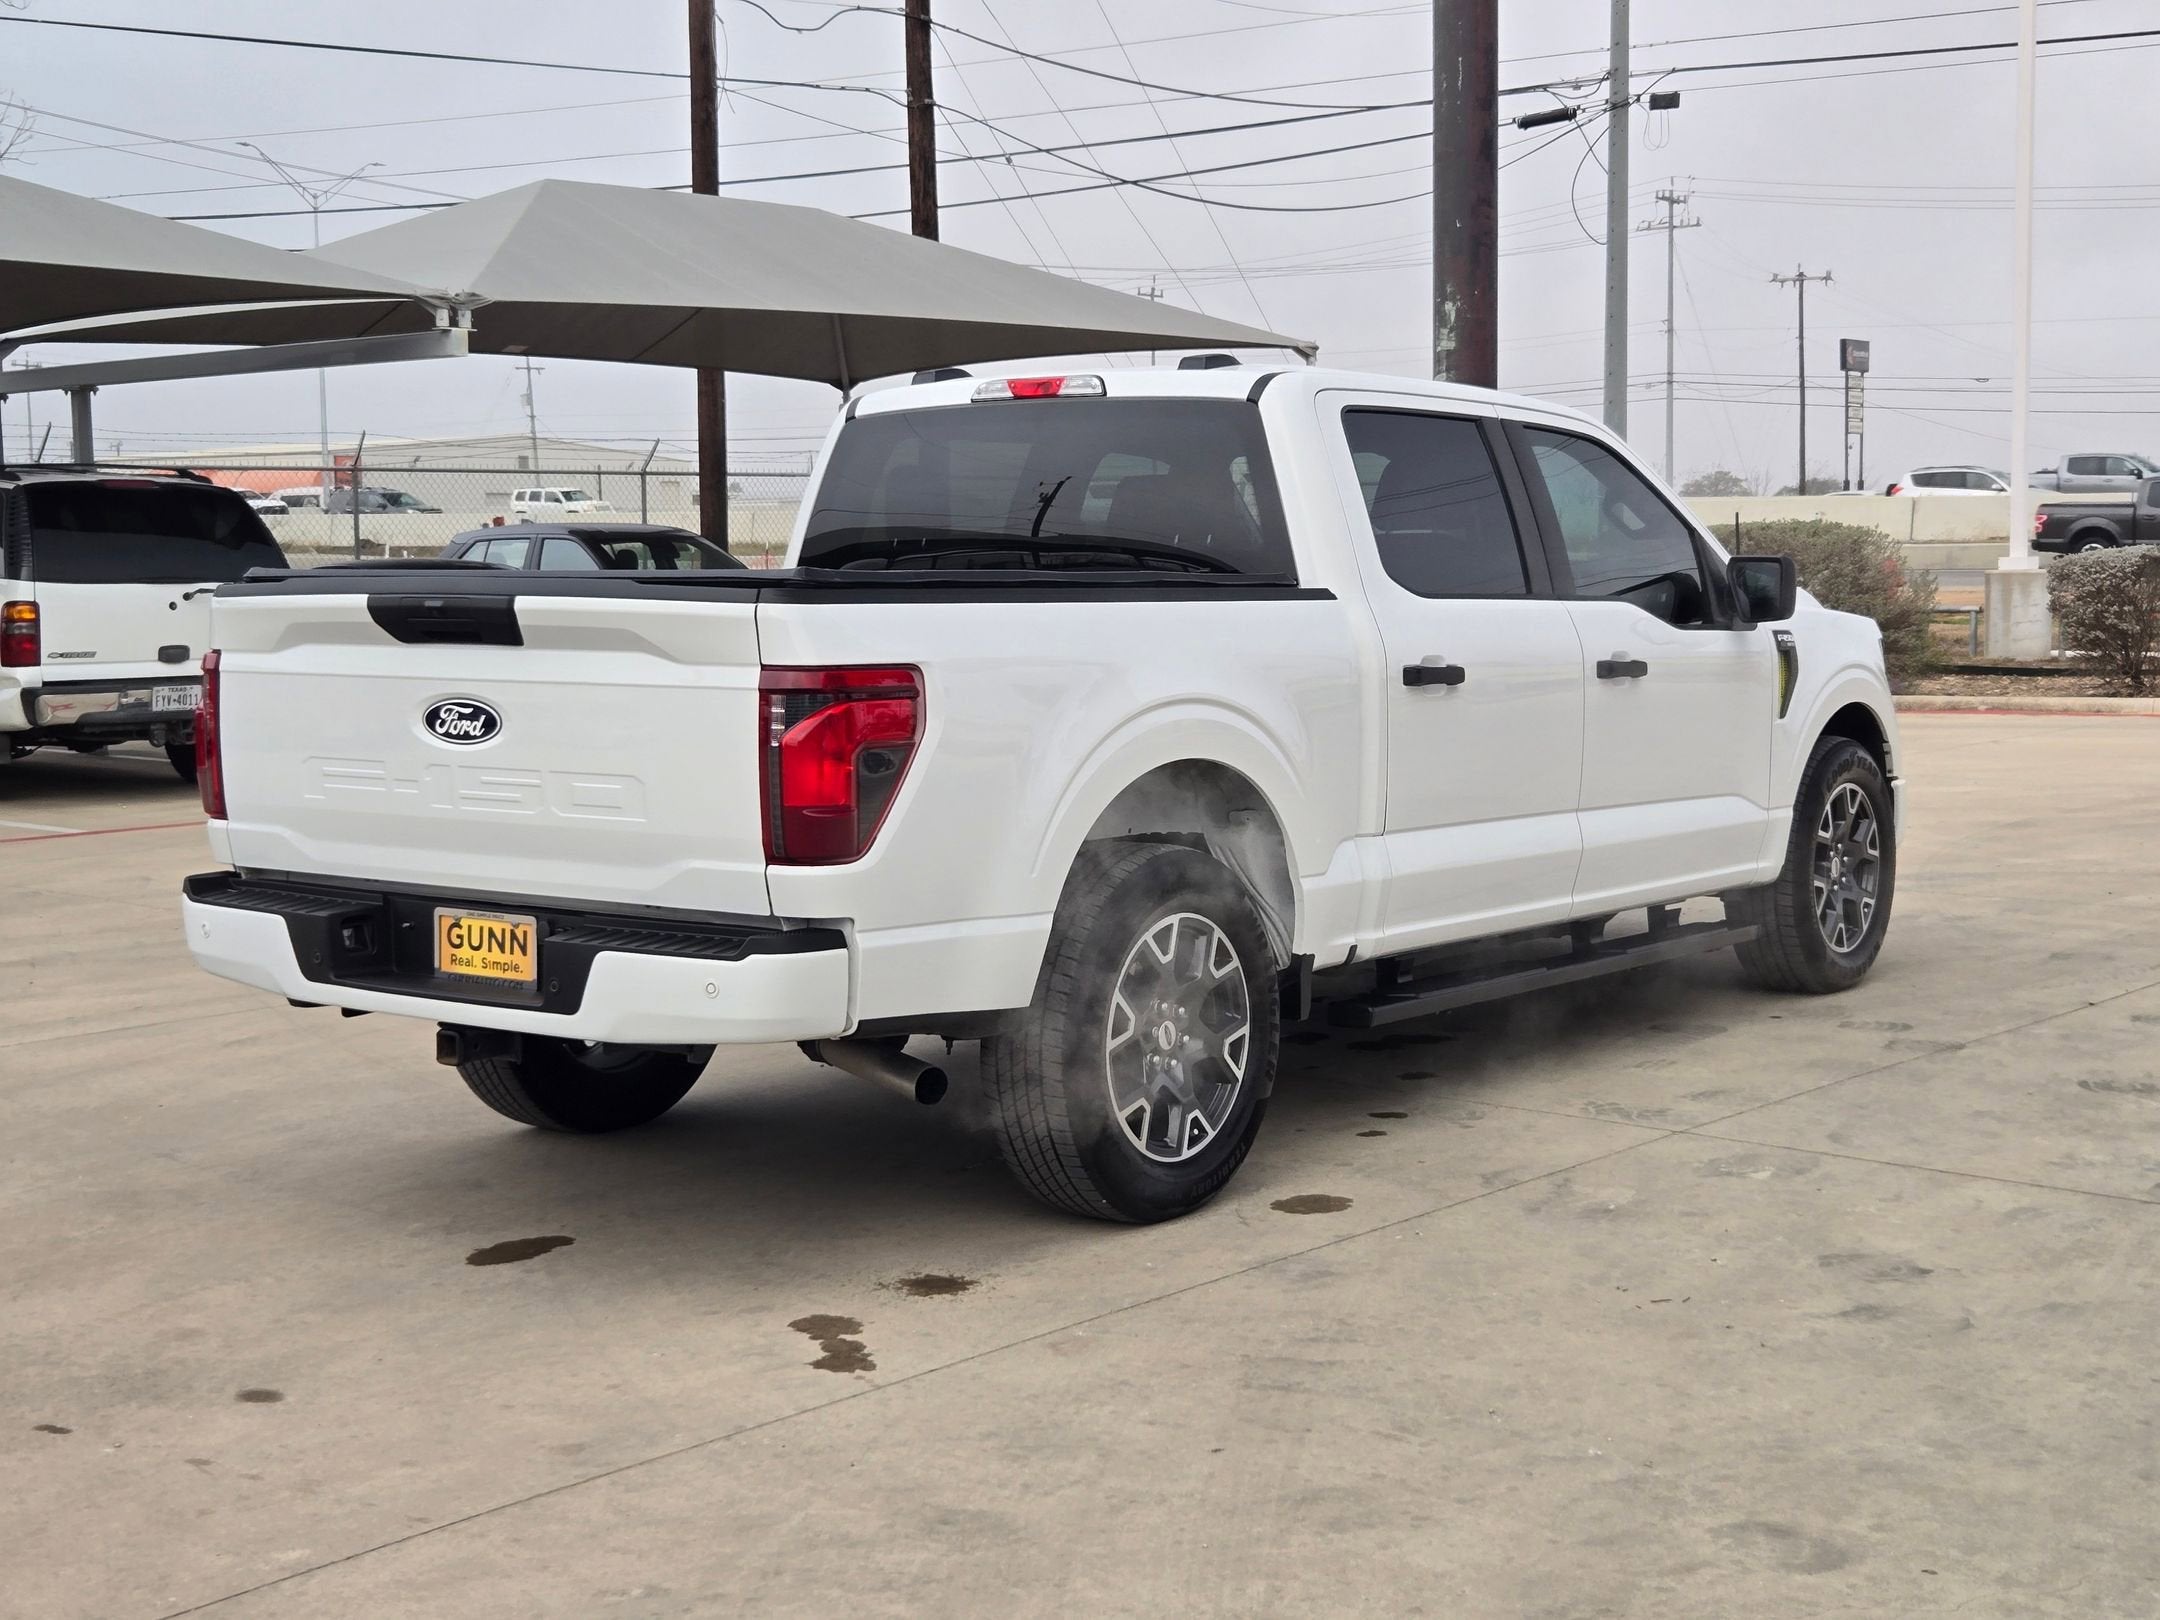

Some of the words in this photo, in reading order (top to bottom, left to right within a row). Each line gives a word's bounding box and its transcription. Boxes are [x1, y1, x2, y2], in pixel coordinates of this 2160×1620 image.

[435, 705, 486, 736] Ford
[302, 755, 647, 822] F-150
[446, 921, 528, 957] GUNN
[450, 953, 477, 968] Real.
